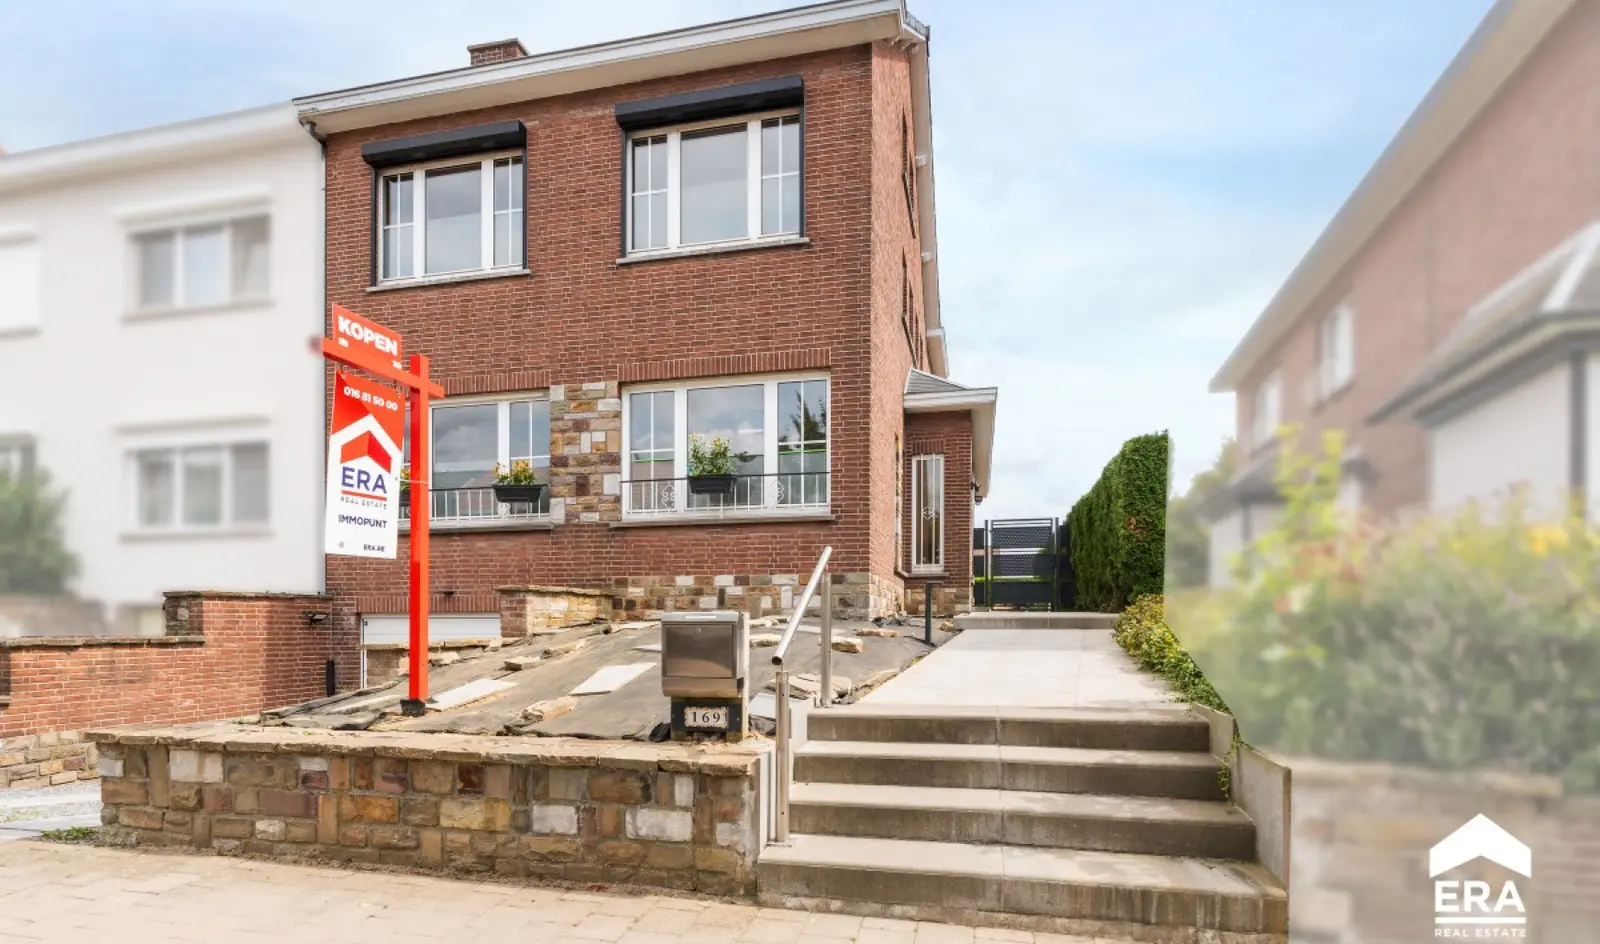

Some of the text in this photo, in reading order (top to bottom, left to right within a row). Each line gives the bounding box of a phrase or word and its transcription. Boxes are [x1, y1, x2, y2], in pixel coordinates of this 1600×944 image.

[338, 315, 398, 356] KOPEN
[343, 386, 398, 411] 016 81 50 00
[341, 466, 387, 494] ERA
[340, 496, 387, 510] REAL ESTATE
[338, 514, 387, 528] IMMOPUNT
[692, 711, 720, 723] 169
